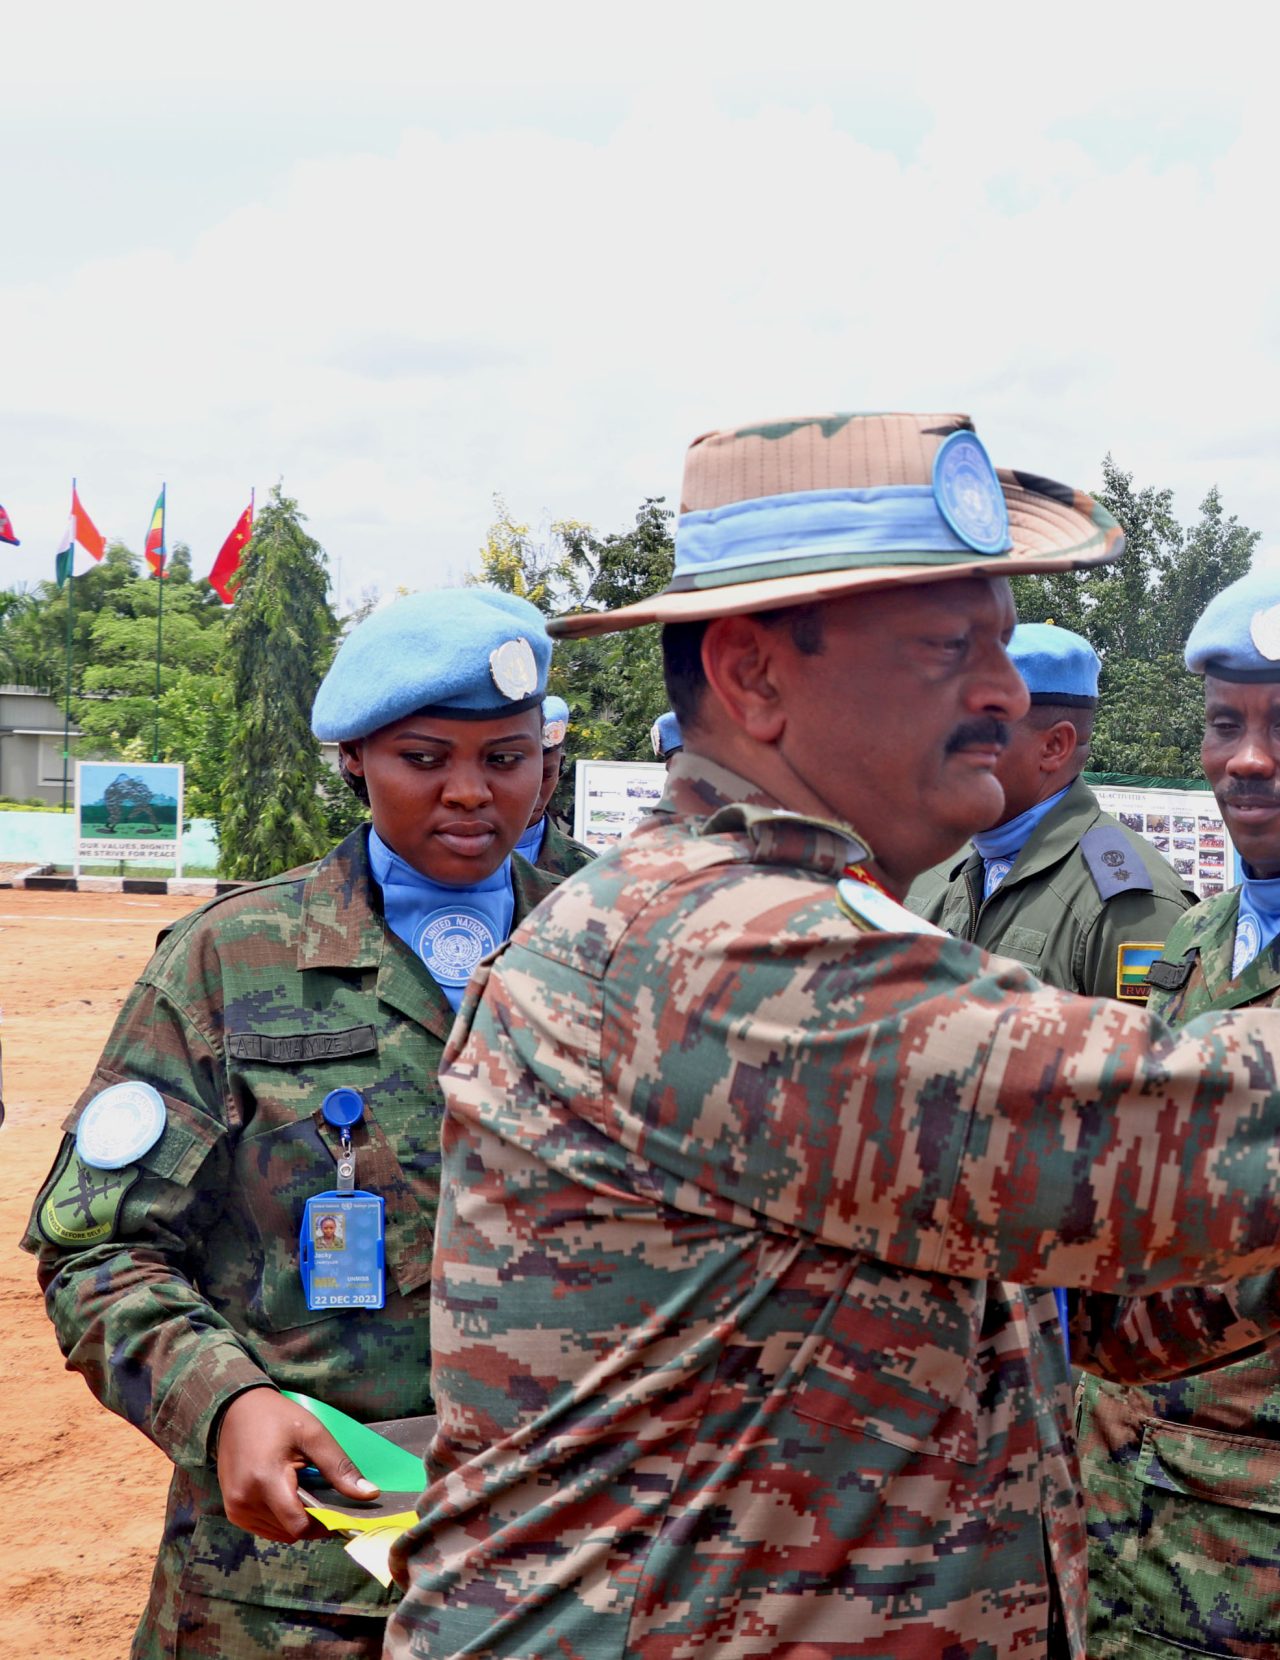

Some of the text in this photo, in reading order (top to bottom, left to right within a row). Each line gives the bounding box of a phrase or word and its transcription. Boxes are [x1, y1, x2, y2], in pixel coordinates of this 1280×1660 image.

[425, 916, 489, 942] UNITED NATIONS
[427, 956, 460, 977] NATIONS
[61, 1229, 86, 1239] BEFORE
[314, 1294, 377, 1305] 22 DEC 2023
